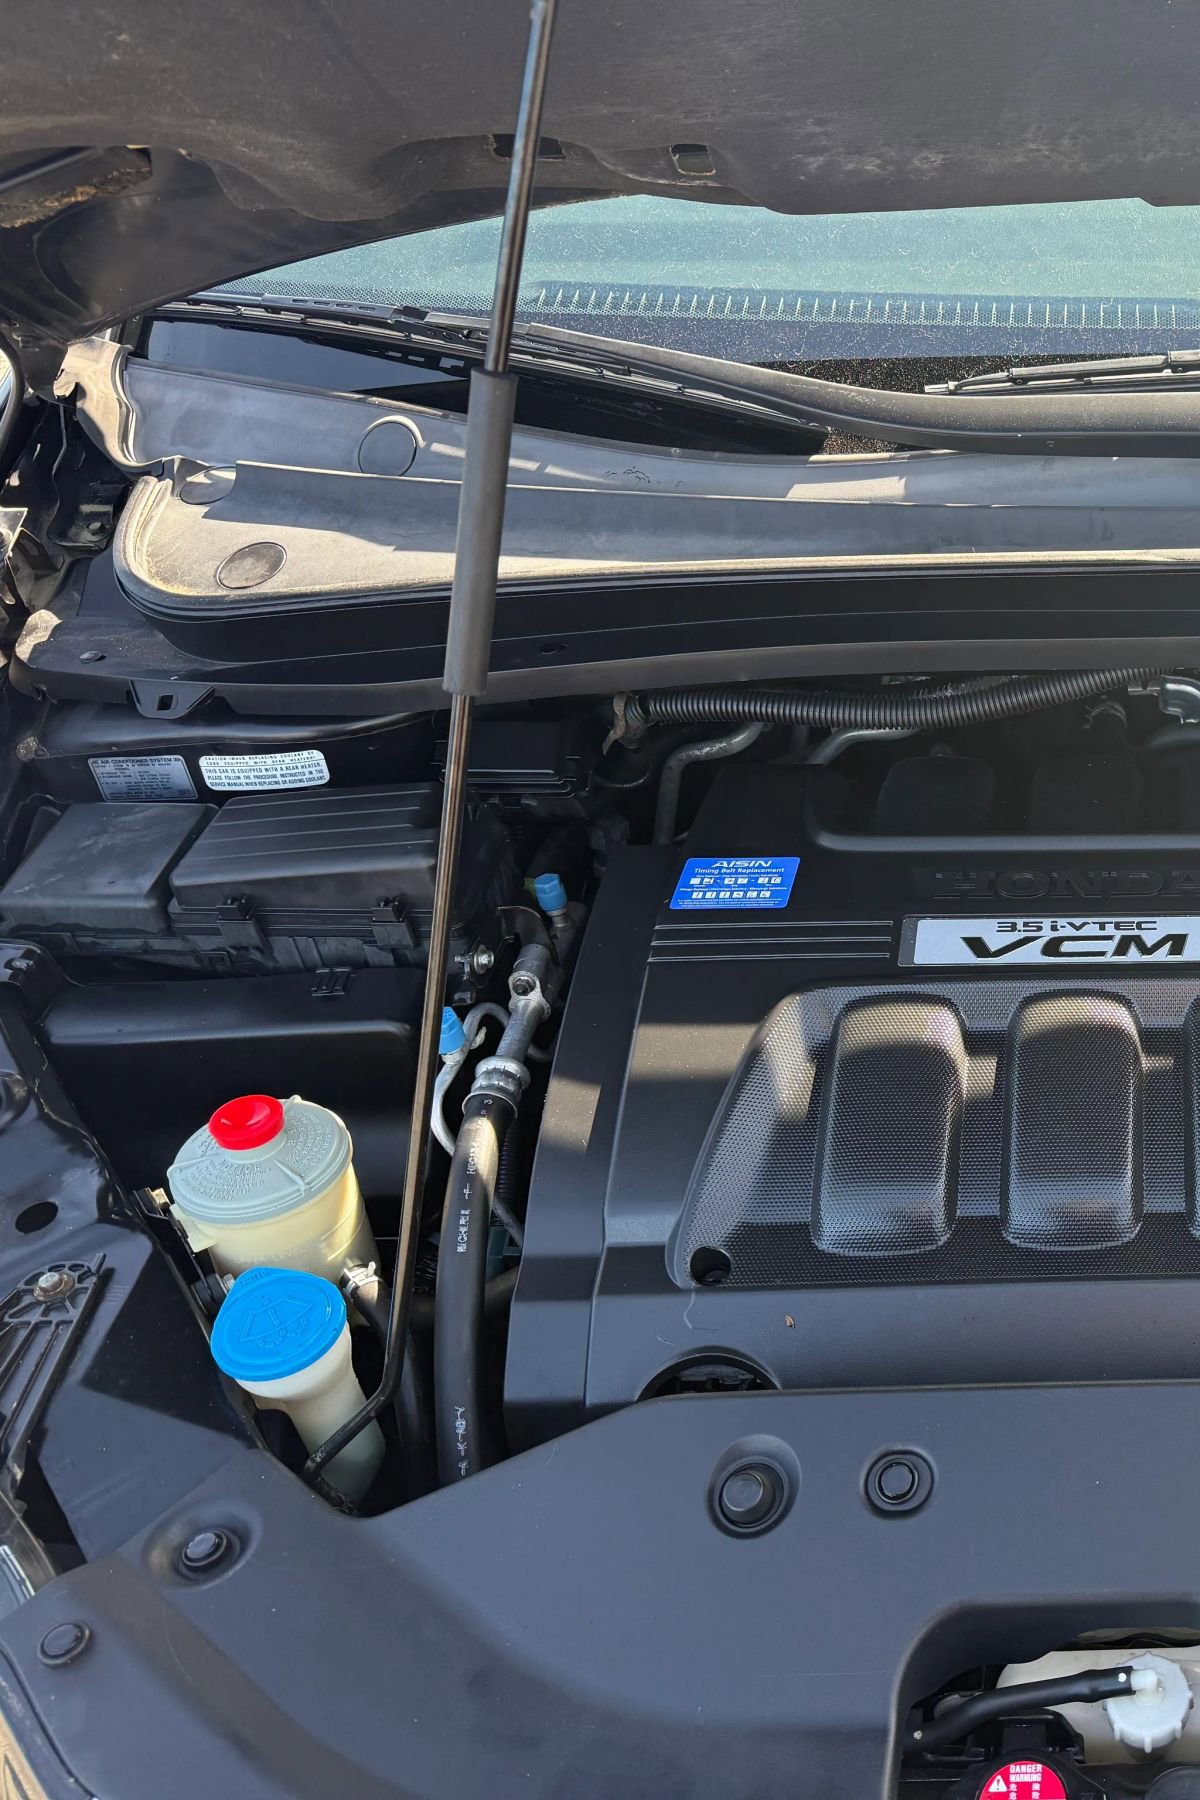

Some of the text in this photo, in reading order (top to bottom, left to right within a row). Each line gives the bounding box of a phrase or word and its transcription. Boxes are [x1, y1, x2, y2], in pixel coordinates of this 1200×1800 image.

[711, 860, 773, 868] AISIN
[996, 920, 1158, 933] 3.5 i-VTEC
[960, 933, 1189, 960] VCM
[1010, 1764, 1042, 1773] DANGER
